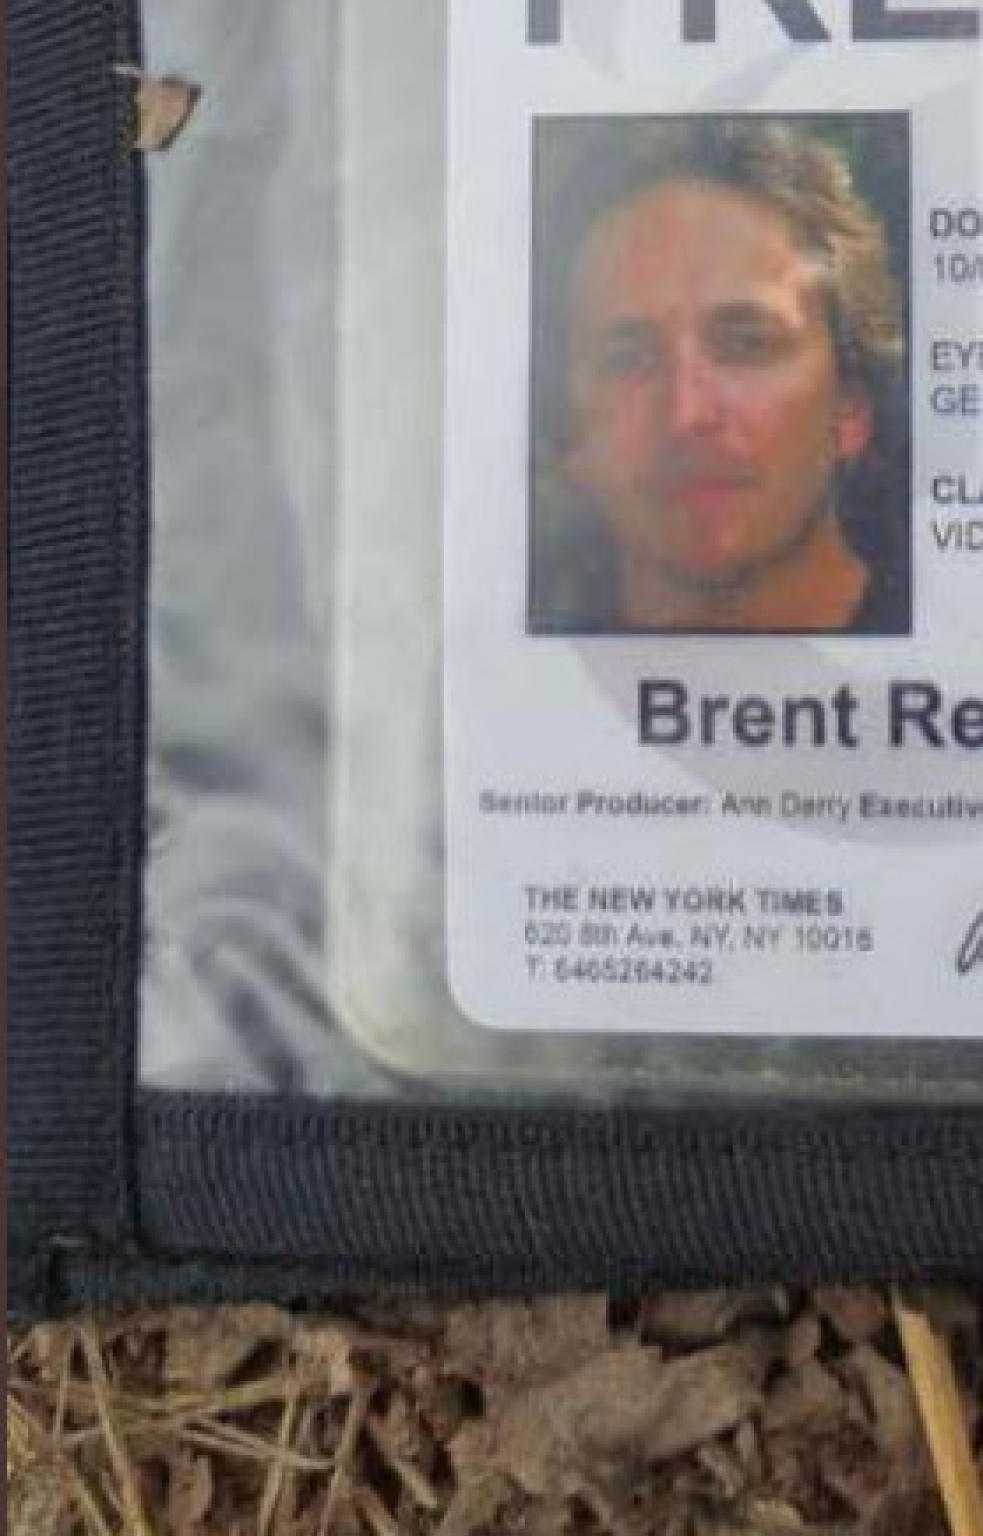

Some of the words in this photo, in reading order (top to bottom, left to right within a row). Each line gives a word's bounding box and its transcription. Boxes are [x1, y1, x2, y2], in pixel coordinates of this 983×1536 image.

[638, 679, 859, 748] Brent
[479, 789, 568, 816] Senior
[577, 790, 711, 817] Producer:
[721, 791, 772, 818] Ann
[525, 886, 578, 913] THE
[588, 887, 656, 913] NEW
[664, 887, 745, 914] YORK
[754, 888, 843, 916] TIMES
[744, 925, 781, 952] NY
